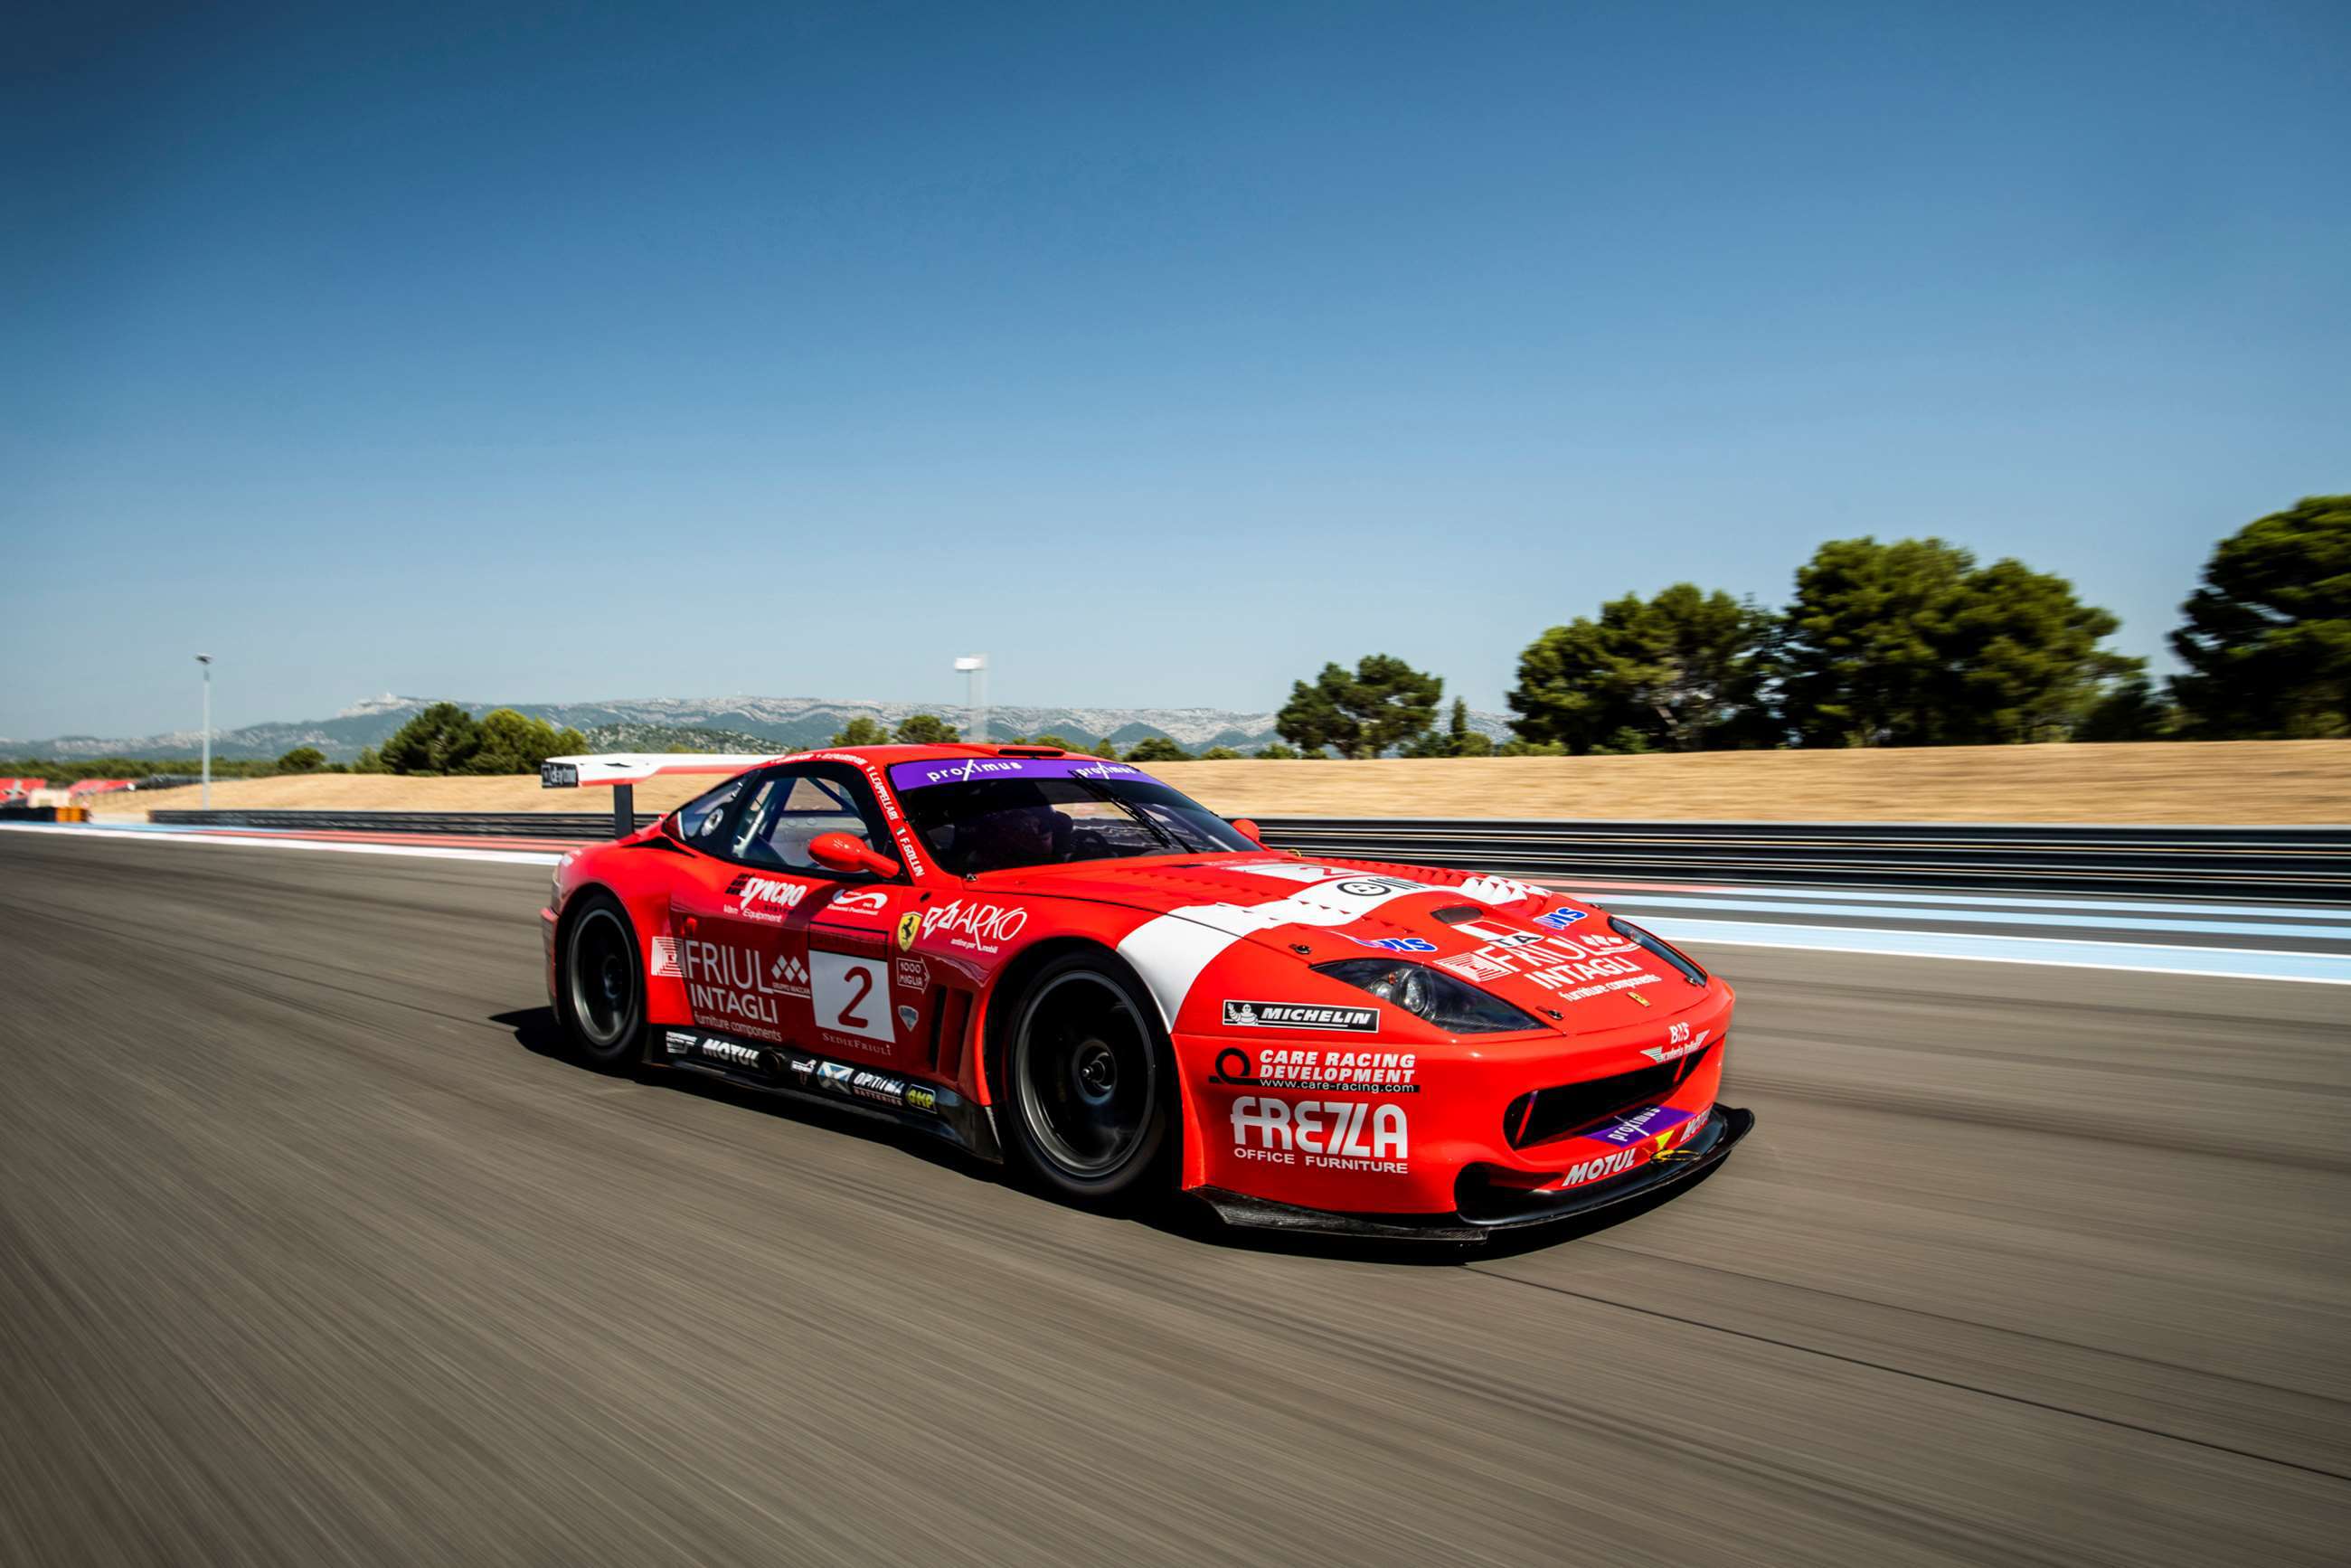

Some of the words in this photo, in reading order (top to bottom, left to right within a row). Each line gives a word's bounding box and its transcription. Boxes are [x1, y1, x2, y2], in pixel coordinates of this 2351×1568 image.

[927, 760, 1023, 781] proximus
[740, 877, 807, 910] SYNCRO
[685, 940, 774, 995] FRIUL
[900, 962, 921, 974] 1000
[1524, 957, 1642, 990] INTAGLI
[690, 983, 779, 1025] INTAGLI
[837, 966, 873, 1029] 2
[694, 1011, 731, 1030] furniture
[731, 1021, 783, 1042] components
[1260, 1007, 1372, 1025] MICHELIN
[703, 1038, 760, 1068] MOTUL
[1260, 1049, 1319, 1065] CARE
[1325, 1053, 1416, 1068] RACING
[1260, 1064, 1415, 1083] DEVELOPMENT
[1260, 1079, 1414, 1093] www.care-racing.com
[1230, 1096, 1408, 1159] FREZZA
[1607, 1108, 1661, 1142] proximus
[1234, 1148, 1295, 1165] OFFICE
[1305, 1156, 1408, 1174] FURNITURE
[1562, 1148, 1637, 1186] MOTUL
